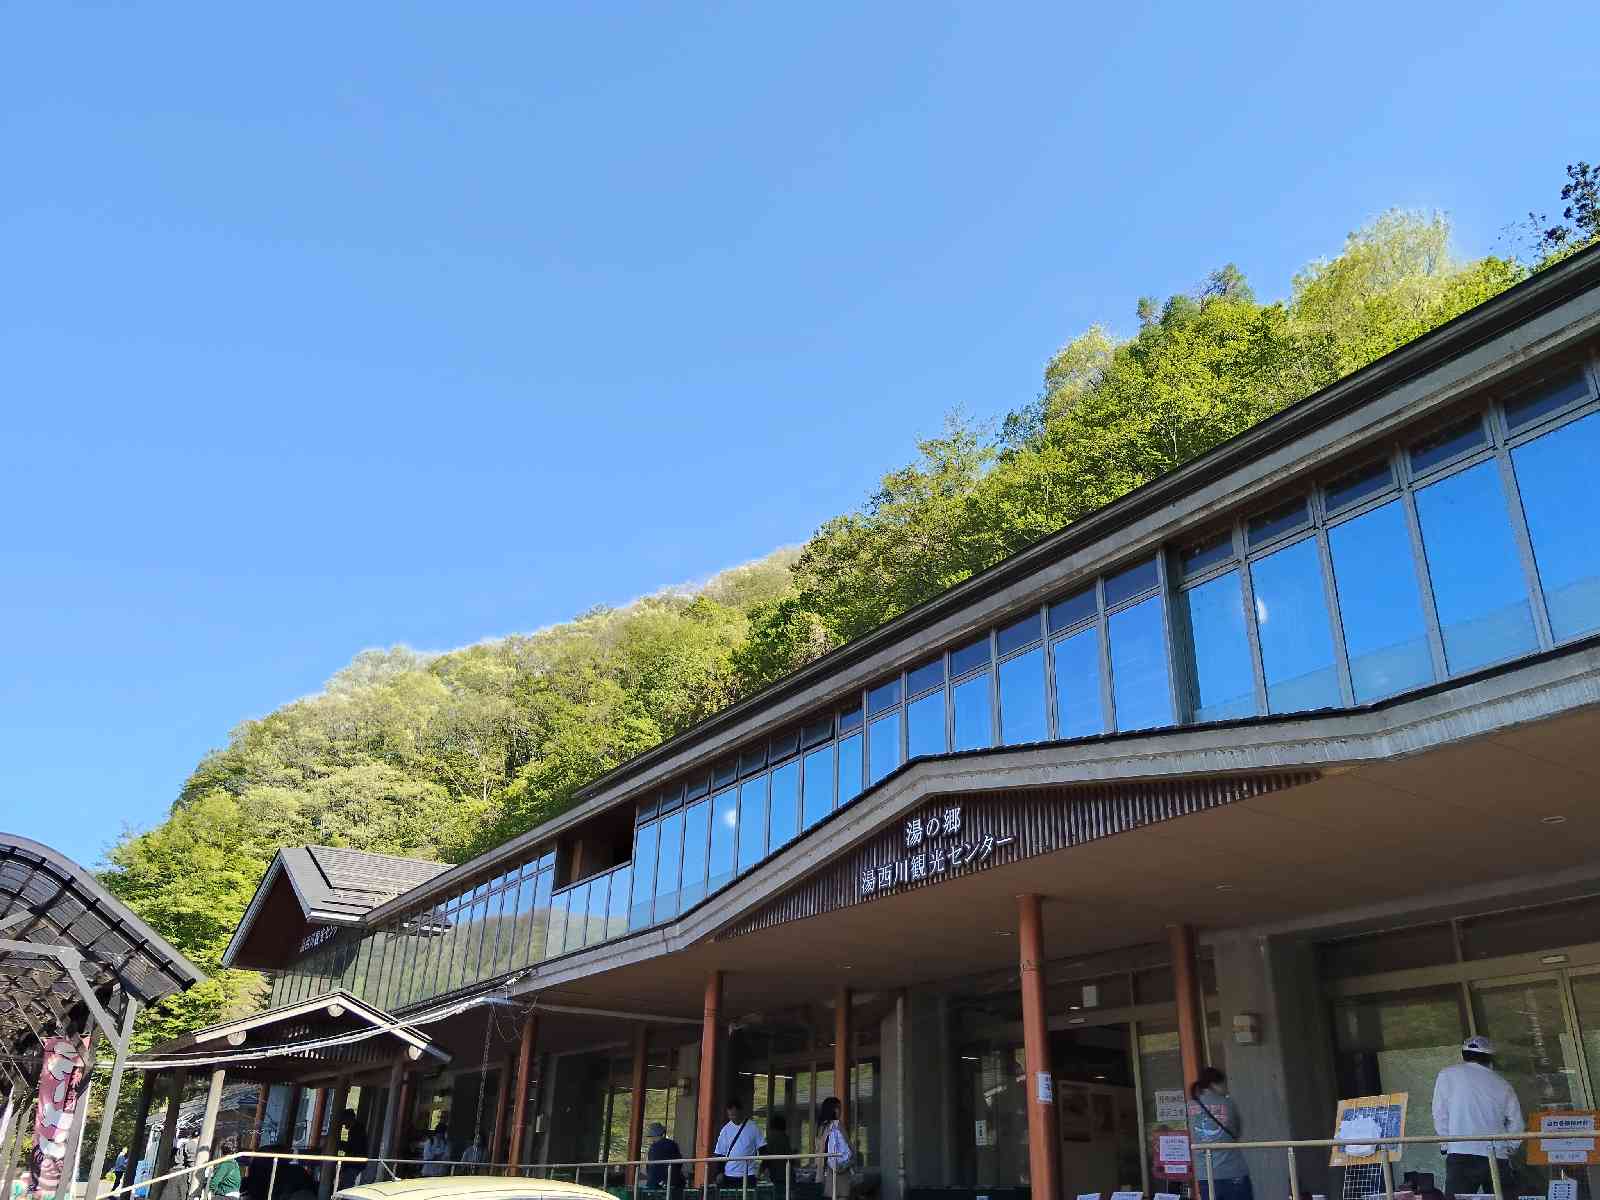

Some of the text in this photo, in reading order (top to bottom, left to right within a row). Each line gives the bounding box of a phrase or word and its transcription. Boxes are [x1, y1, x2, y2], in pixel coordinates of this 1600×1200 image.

[905, 807, 962, 847] 湯の郷
[861, 832, 1016, 894] 湯西川観光センター
